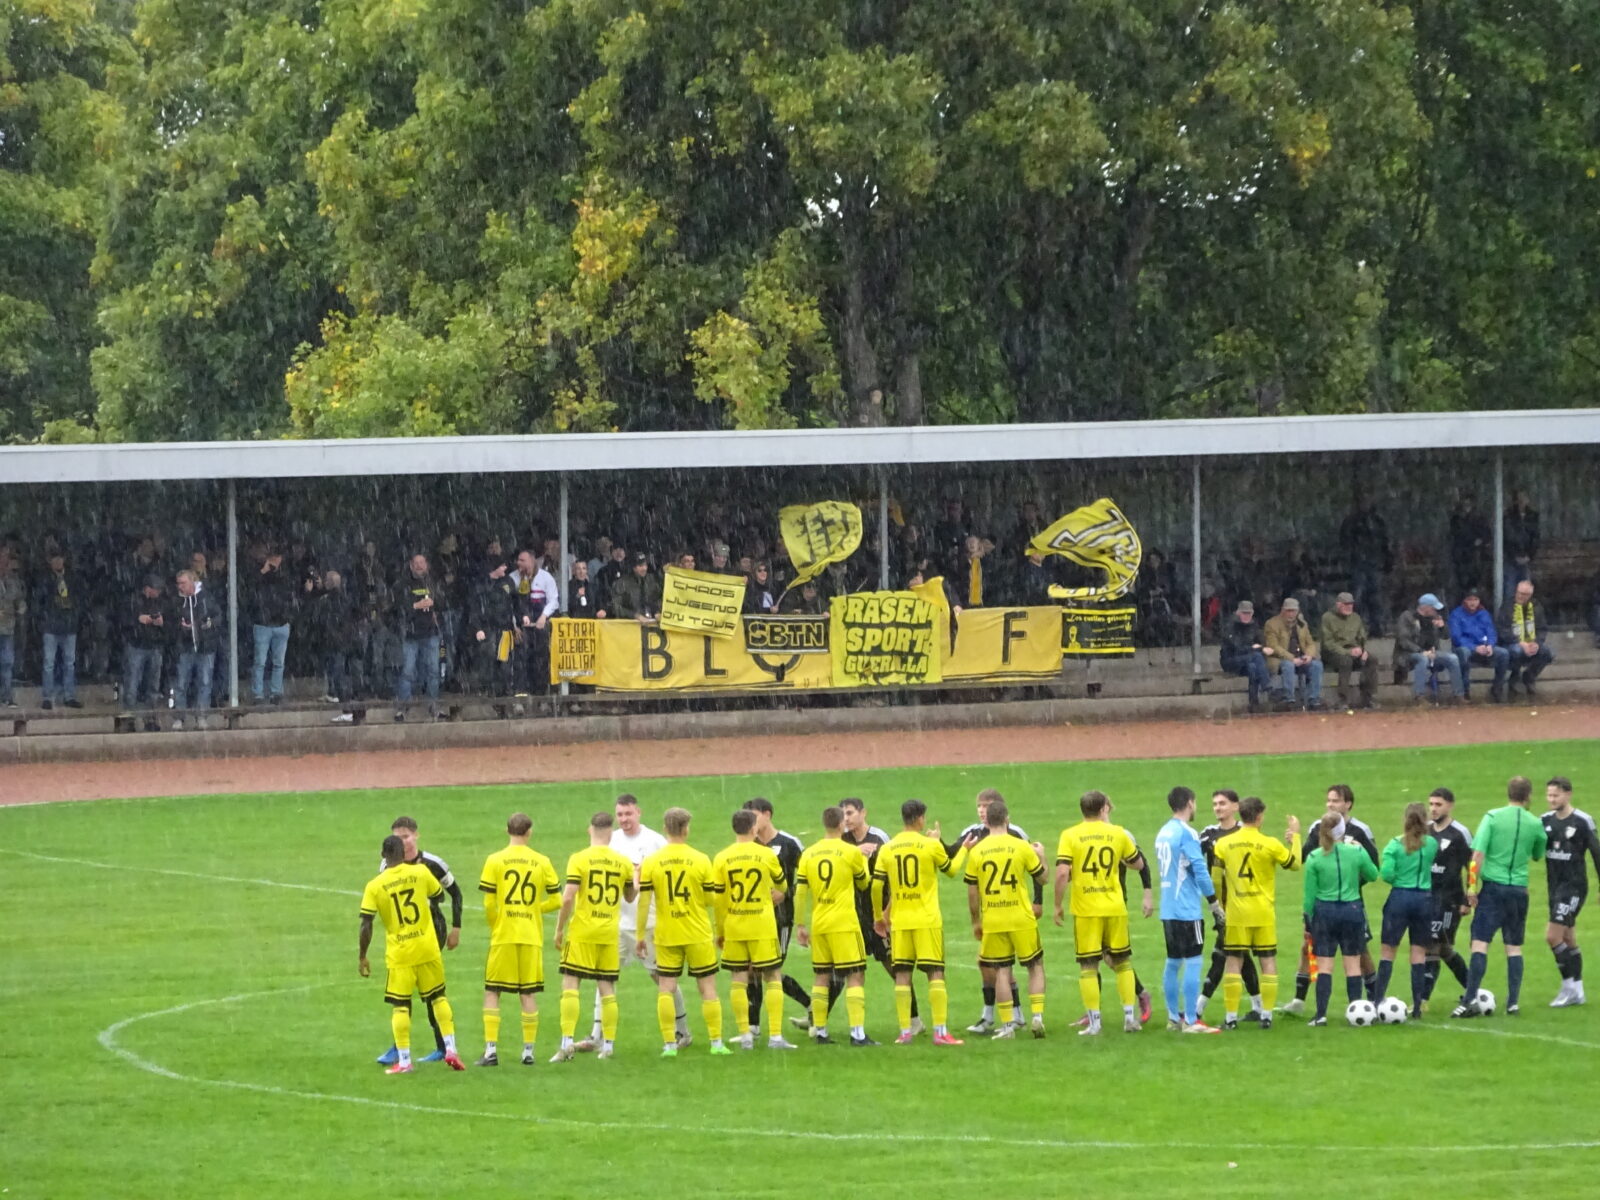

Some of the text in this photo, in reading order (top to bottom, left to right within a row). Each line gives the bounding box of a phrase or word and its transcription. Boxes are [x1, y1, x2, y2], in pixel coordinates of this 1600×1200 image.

[666, 596, 738, 615] JUGEND
[673, 580, 735, 598] CHAOS
[662, 610, 736, 631] ON TOUR
[843, 596, 932, 625] RASEN
[845, 626, 932, 653] SPORT
[1002, 611, 1028, 665] F
[558, 654, 596, 670] JULIAN
[818, 859, 833, 889] 9
[894, 853, 919, 888] 10
[982, 858, 1018, 895] 24
[1081, 846, 1114, 880] 49
[1238, 852, 1254, 885] 4
[504, 869, 537, 906] 26
[588, 869, 621, 907] 55
[665, 870, 691, 905] 14
[728, 868, 762, 903] 52
[391, 888, 420, 928] 13
[1557, 903, 1570, 915] 30
[1431, 921, 1443, 932] 27
